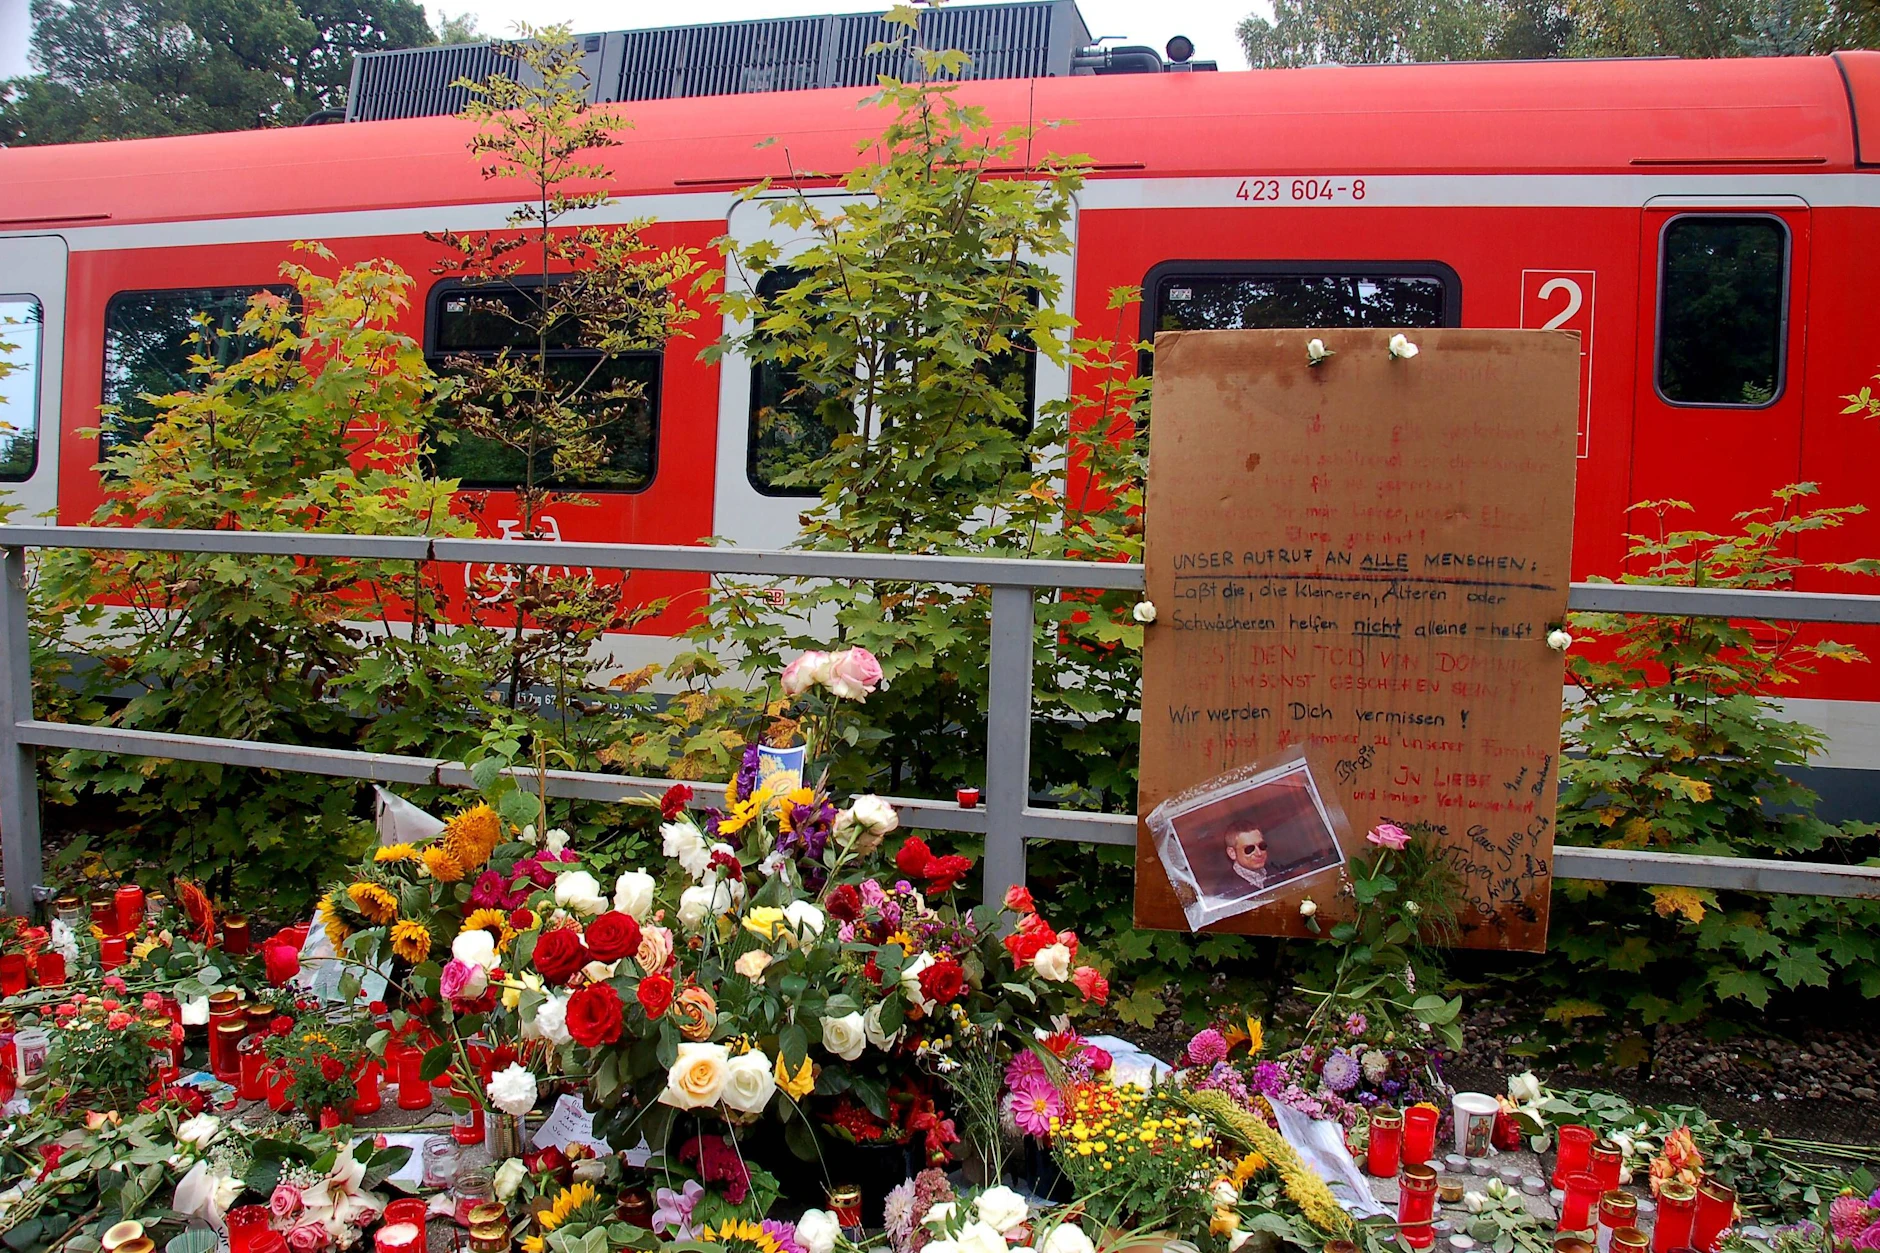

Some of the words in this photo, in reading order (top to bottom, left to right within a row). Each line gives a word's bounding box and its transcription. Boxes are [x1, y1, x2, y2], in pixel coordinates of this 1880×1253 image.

[1236, 180, 1280, 201] 423
[1291, 179, 1366, 201] 604-8
[1537, 277, 1583, 330] 2
[1173, 551, 1234, 570] UNSER
[1243, 549, 1313, 565] AUFRUF
[1325, 550, 1352, 565] AN
[1360, 553, 1409, 569] ALLE
[1259, 579, 1288, 598] die
[1466, 591, 1507, 605] oder
[1289, 612, 1339, 633] helfen
[1353, 616, 1403, 635] nicht
[1414, 621, 1468, 637] alleine
[1491, 621, 1533, 639] helft
[1251, 644, 1297, 666] DEN
[1313, 645, 1365, 668] TOD
[1168, 703, 1201, 725] Wir
[1207, 702, 1271, 721] werden
[1288, 702, 1333, 721] Dich
[1356, 708, 1445, 726] vermissen
[1353, 789, 1376, 801] und
